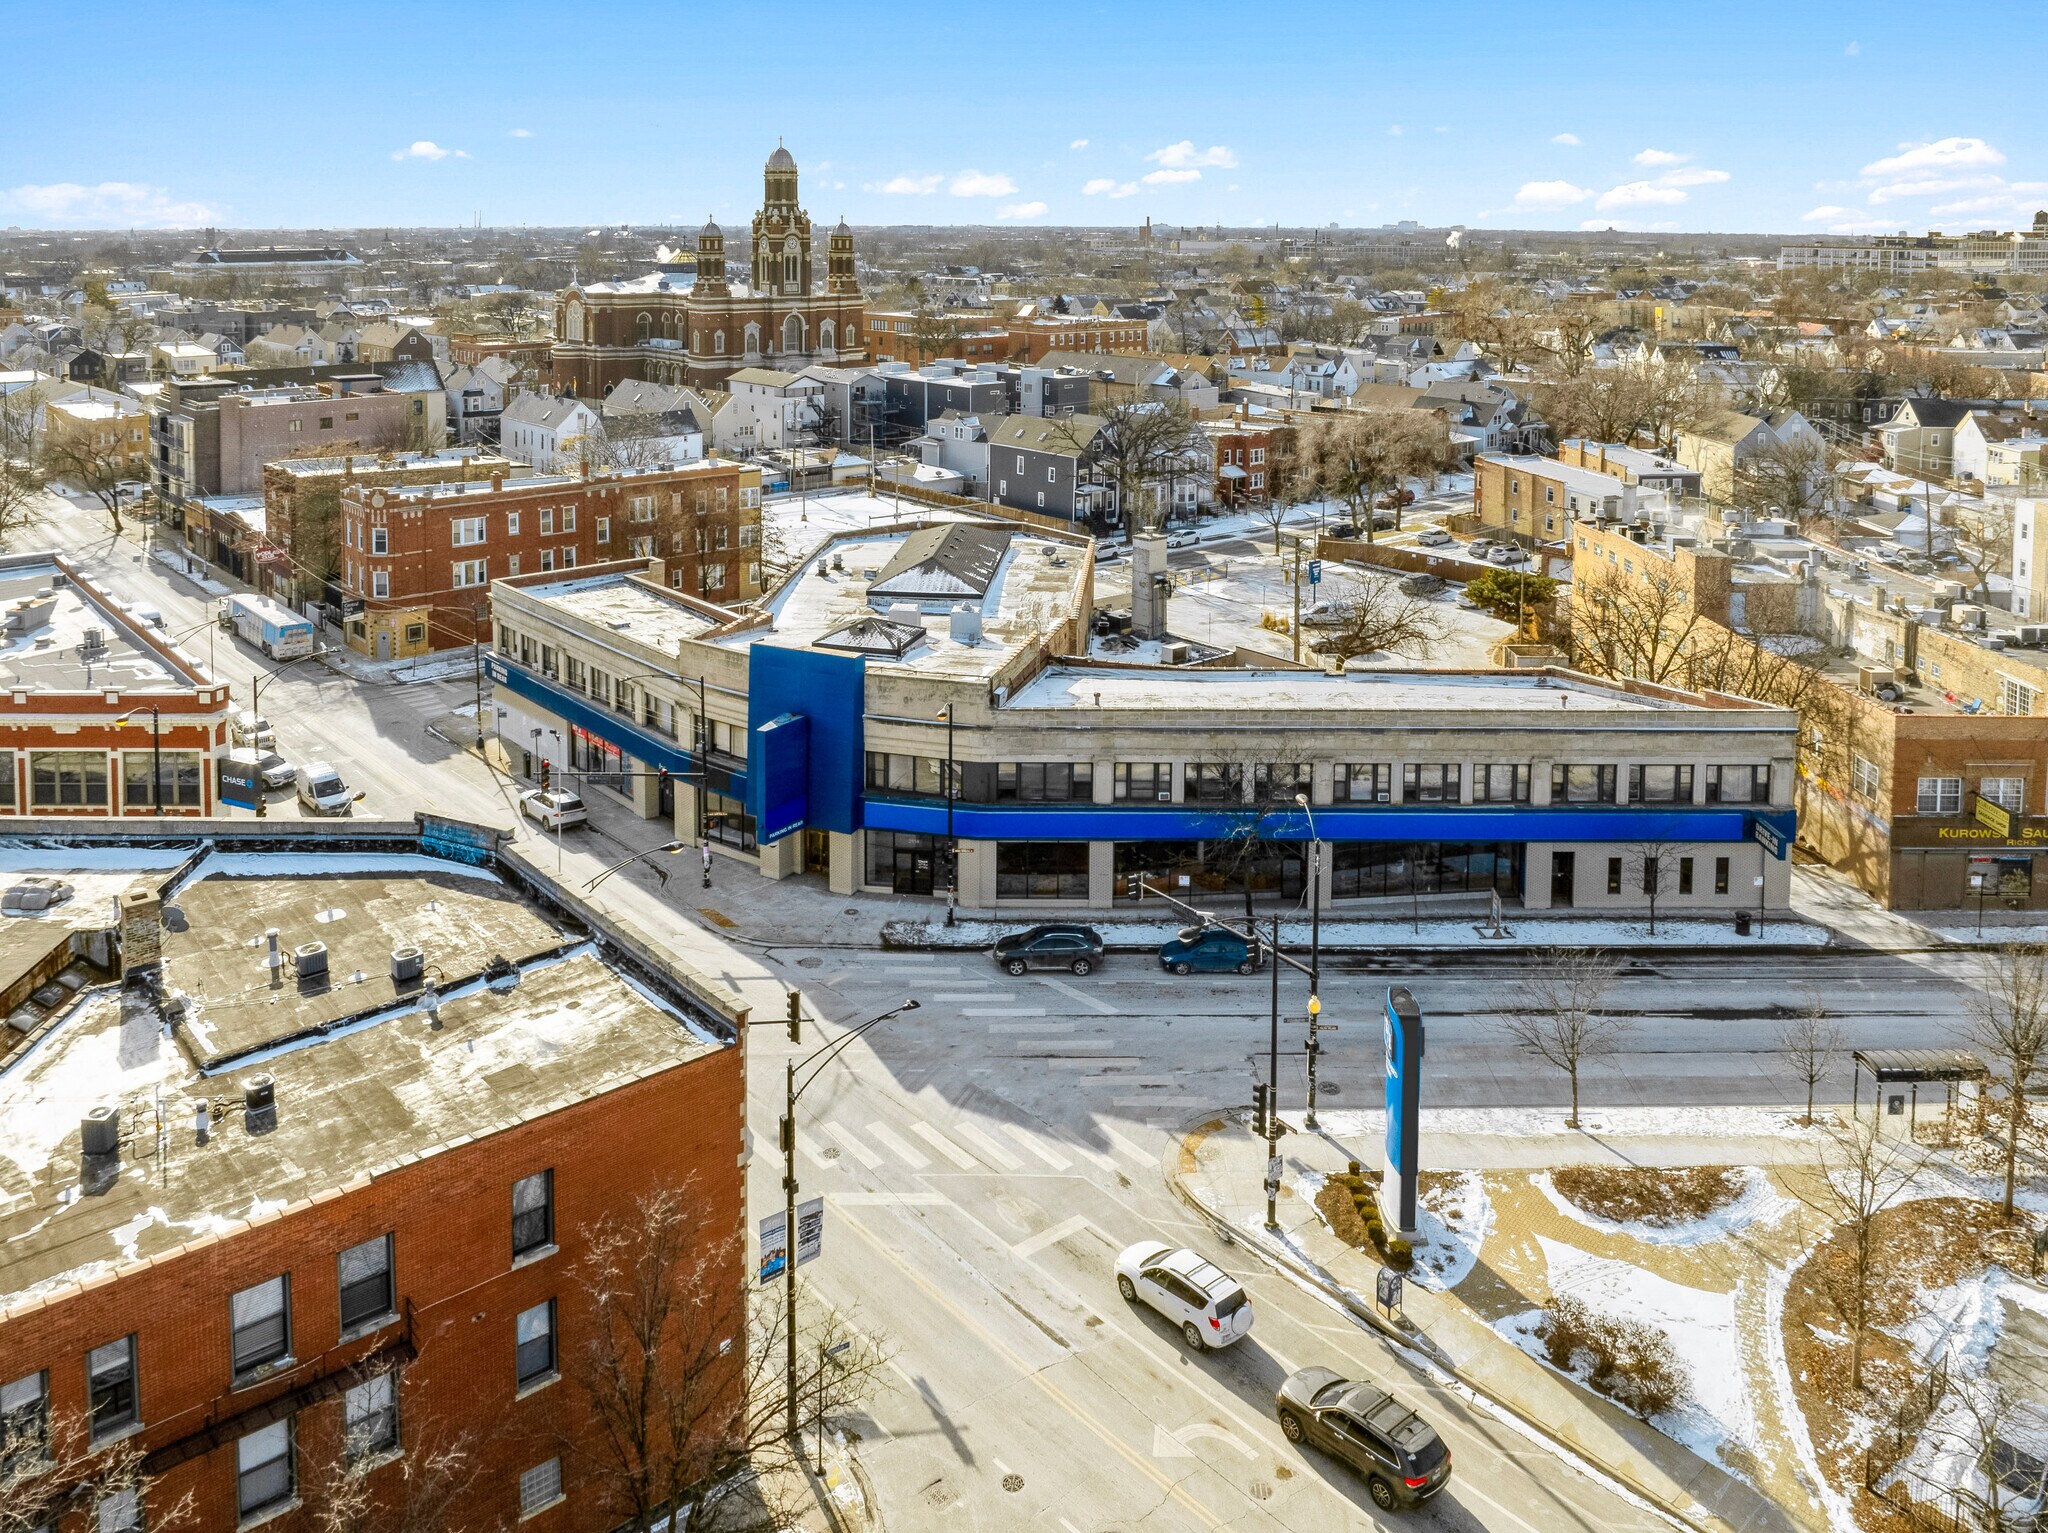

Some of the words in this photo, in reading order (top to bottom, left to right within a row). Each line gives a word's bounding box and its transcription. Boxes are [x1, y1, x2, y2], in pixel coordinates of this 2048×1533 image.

[491, 661, 508, 676] PARKING
[496, 672, 507, 684] REAR
[222, 775, 246, 786] CHASE
[769, 827, 788, 838] PARKING
[792, 820, 803, 828] REAR
[1939, 828, 2004, 838] KUROWS
